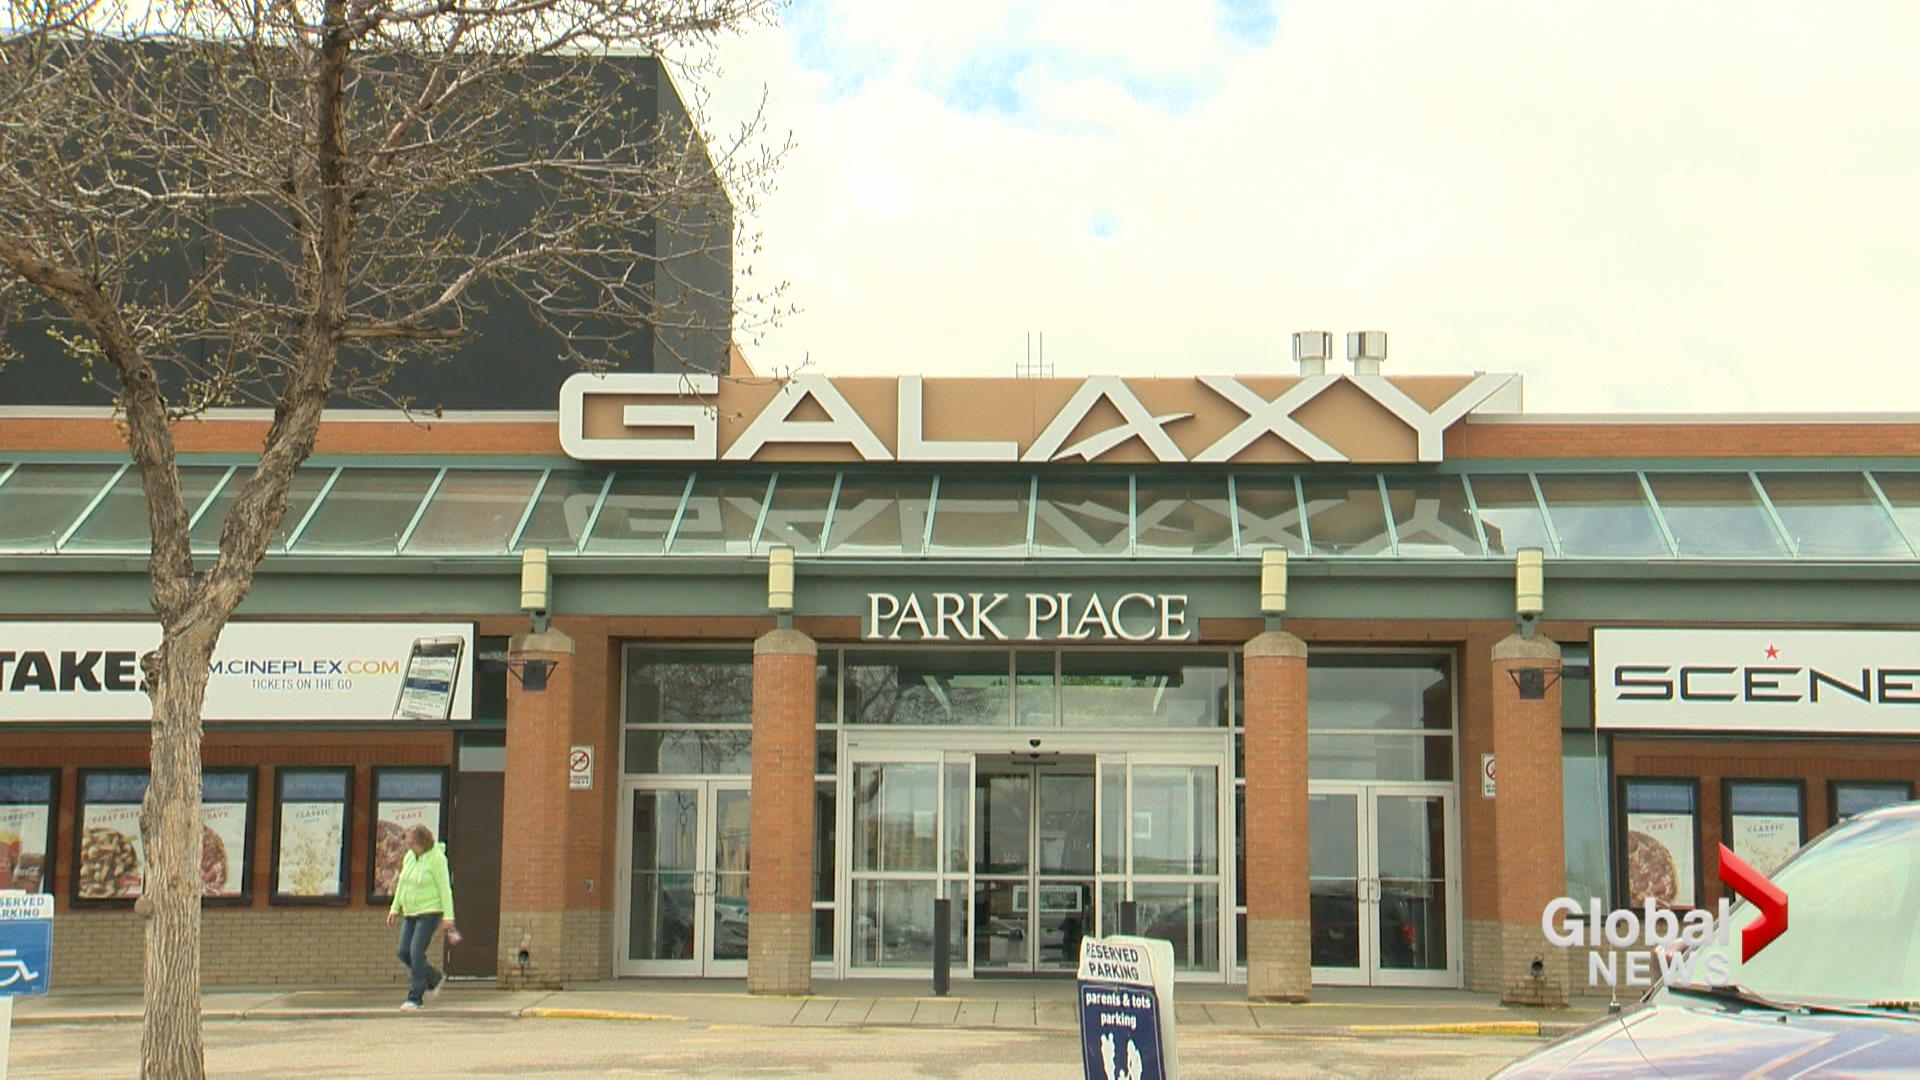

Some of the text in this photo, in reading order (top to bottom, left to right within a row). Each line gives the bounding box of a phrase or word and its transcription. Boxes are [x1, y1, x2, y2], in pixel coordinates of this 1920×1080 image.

[559, 373, 1518, 462] GALAXY
[867, 592, 1192, 640] PARK PLACE
[0, 651, 148, 692] AKE
[252, 679, 353, 690] TICKETS ON THE GO
[1614, 665, 1920, 703] SCENE
[0, 908, 40, 918] RKING
[1086, 943, 1139, 962] RESERVED
[1089, 962, 1139, 980] PARKING
[1086, 992, 1151, 1009] parents & tots
[1101, 1012, 1137, 1030] parking
